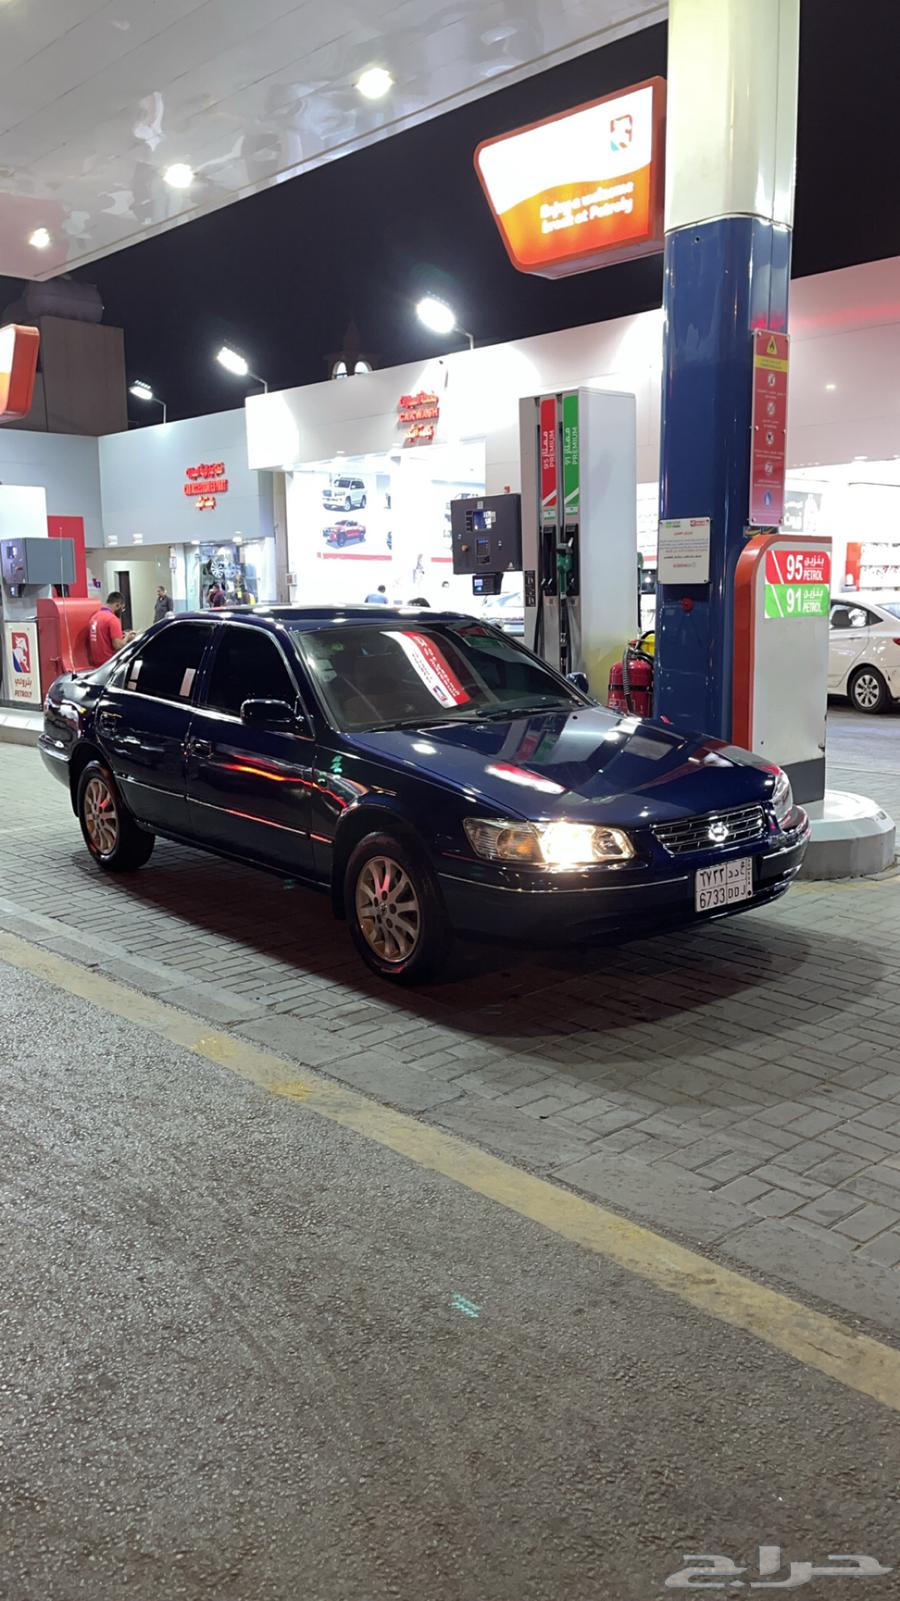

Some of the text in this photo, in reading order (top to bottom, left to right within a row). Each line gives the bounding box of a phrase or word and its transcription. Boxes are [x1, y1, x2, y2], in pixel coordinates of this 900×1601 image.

[786, 554, 804, 581] 95
[804, 555, 825, 567] بنزين
[803, 570, 824, 581] PETROL
[786, 588, 802, 613] 91
[803, 602, 822, 613] PETROL
[699, 887, 726, 909] 6733
